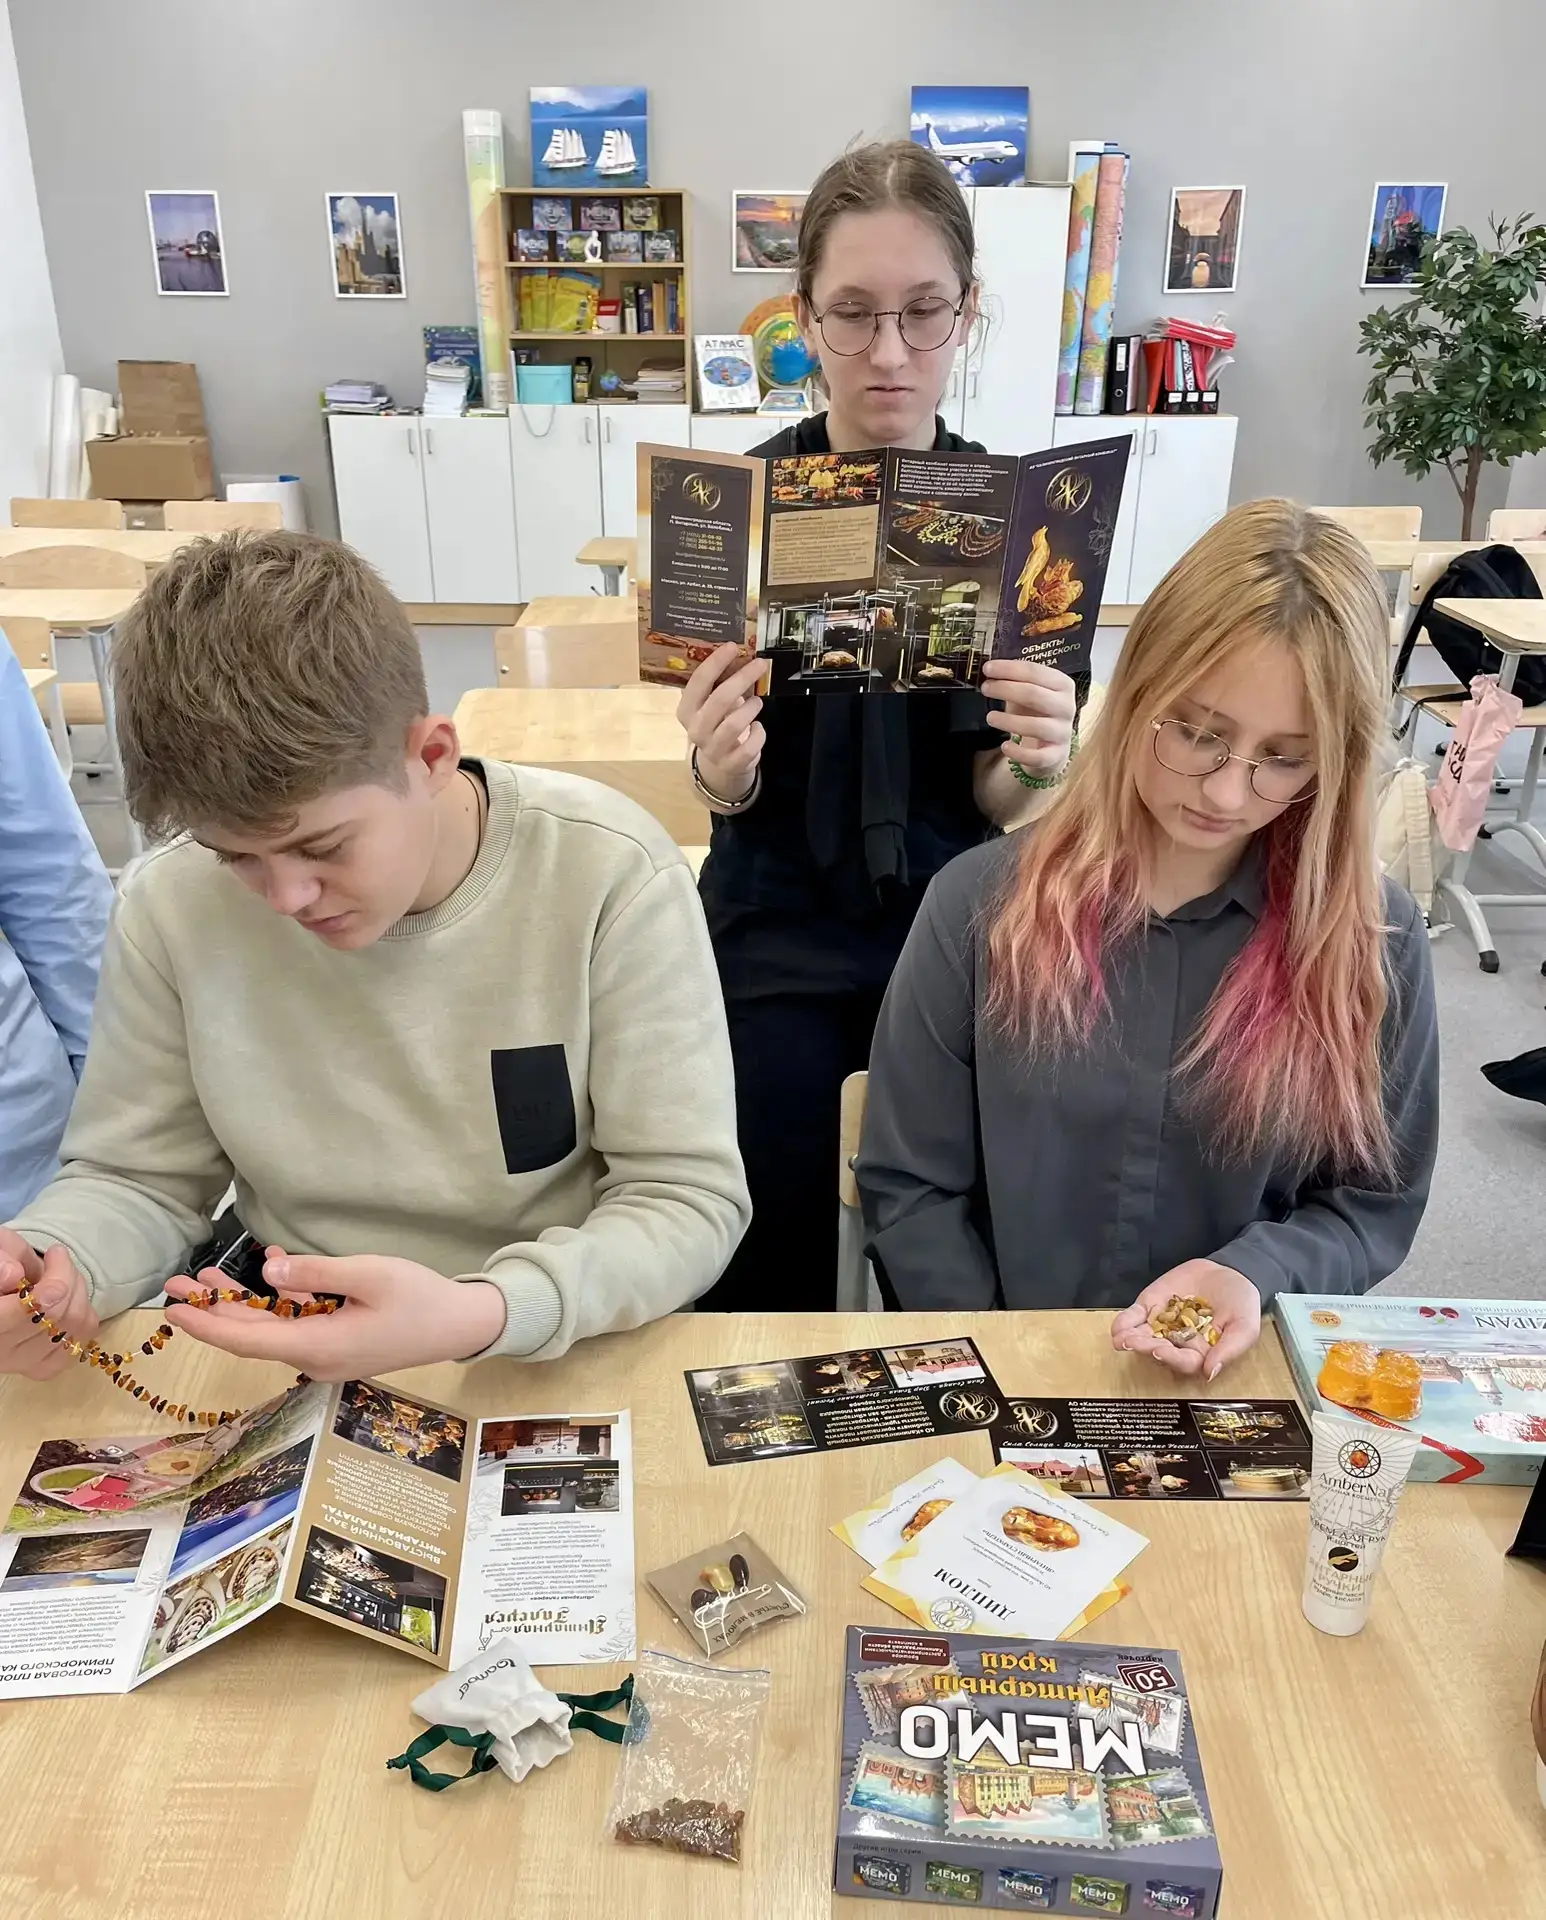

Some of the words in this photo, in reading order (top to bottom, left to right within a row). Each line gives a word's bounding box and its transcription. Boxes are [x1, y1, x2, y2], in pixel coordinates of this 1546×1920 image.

[1020, 637, 1066, 654] ОБЪЕКТЫ
[318, 1502, 377, 1530] ПАЛАТА»
[322, 1513, 349, 1530] ЗАЛ
[348, 1523, 442, 1565] ВЫСТАВОЧНЫЙ
[377, 1524, 448, 1556] «ЯНТАРНАЯ
[933, 1567, 1017, 1622] ДИПЛОМ
[483, 1606, 570, 1626] Галерея
[513, 1615, 606, 1637] Янтарная
[891, 1643, 943, 1652] Калининградской
[21, 1658, 115, 1670] ПРИМОРСКОГО
[982, 1652, 1059, 1677] край
[1115, 1652, 1163, 1664] карточек
[34, 1667, 112, 1681] СМОТРОВАЯ
[1133, 1666, 1169, 1692] 50
[933, 1674, 1112, 1710] Янтарный
[901, 1705, 1150, 1777] МЕМО
[858, 1865, 898, 1884] МЕМО
[932, 1867, 972, 1884] МЕМО
[1004, 1878, 1044, 1896] МЕМО
[1077, 1884, 1117, 1902] МЕМО
[1151, 1888, 1190, 1906] МЕМО
